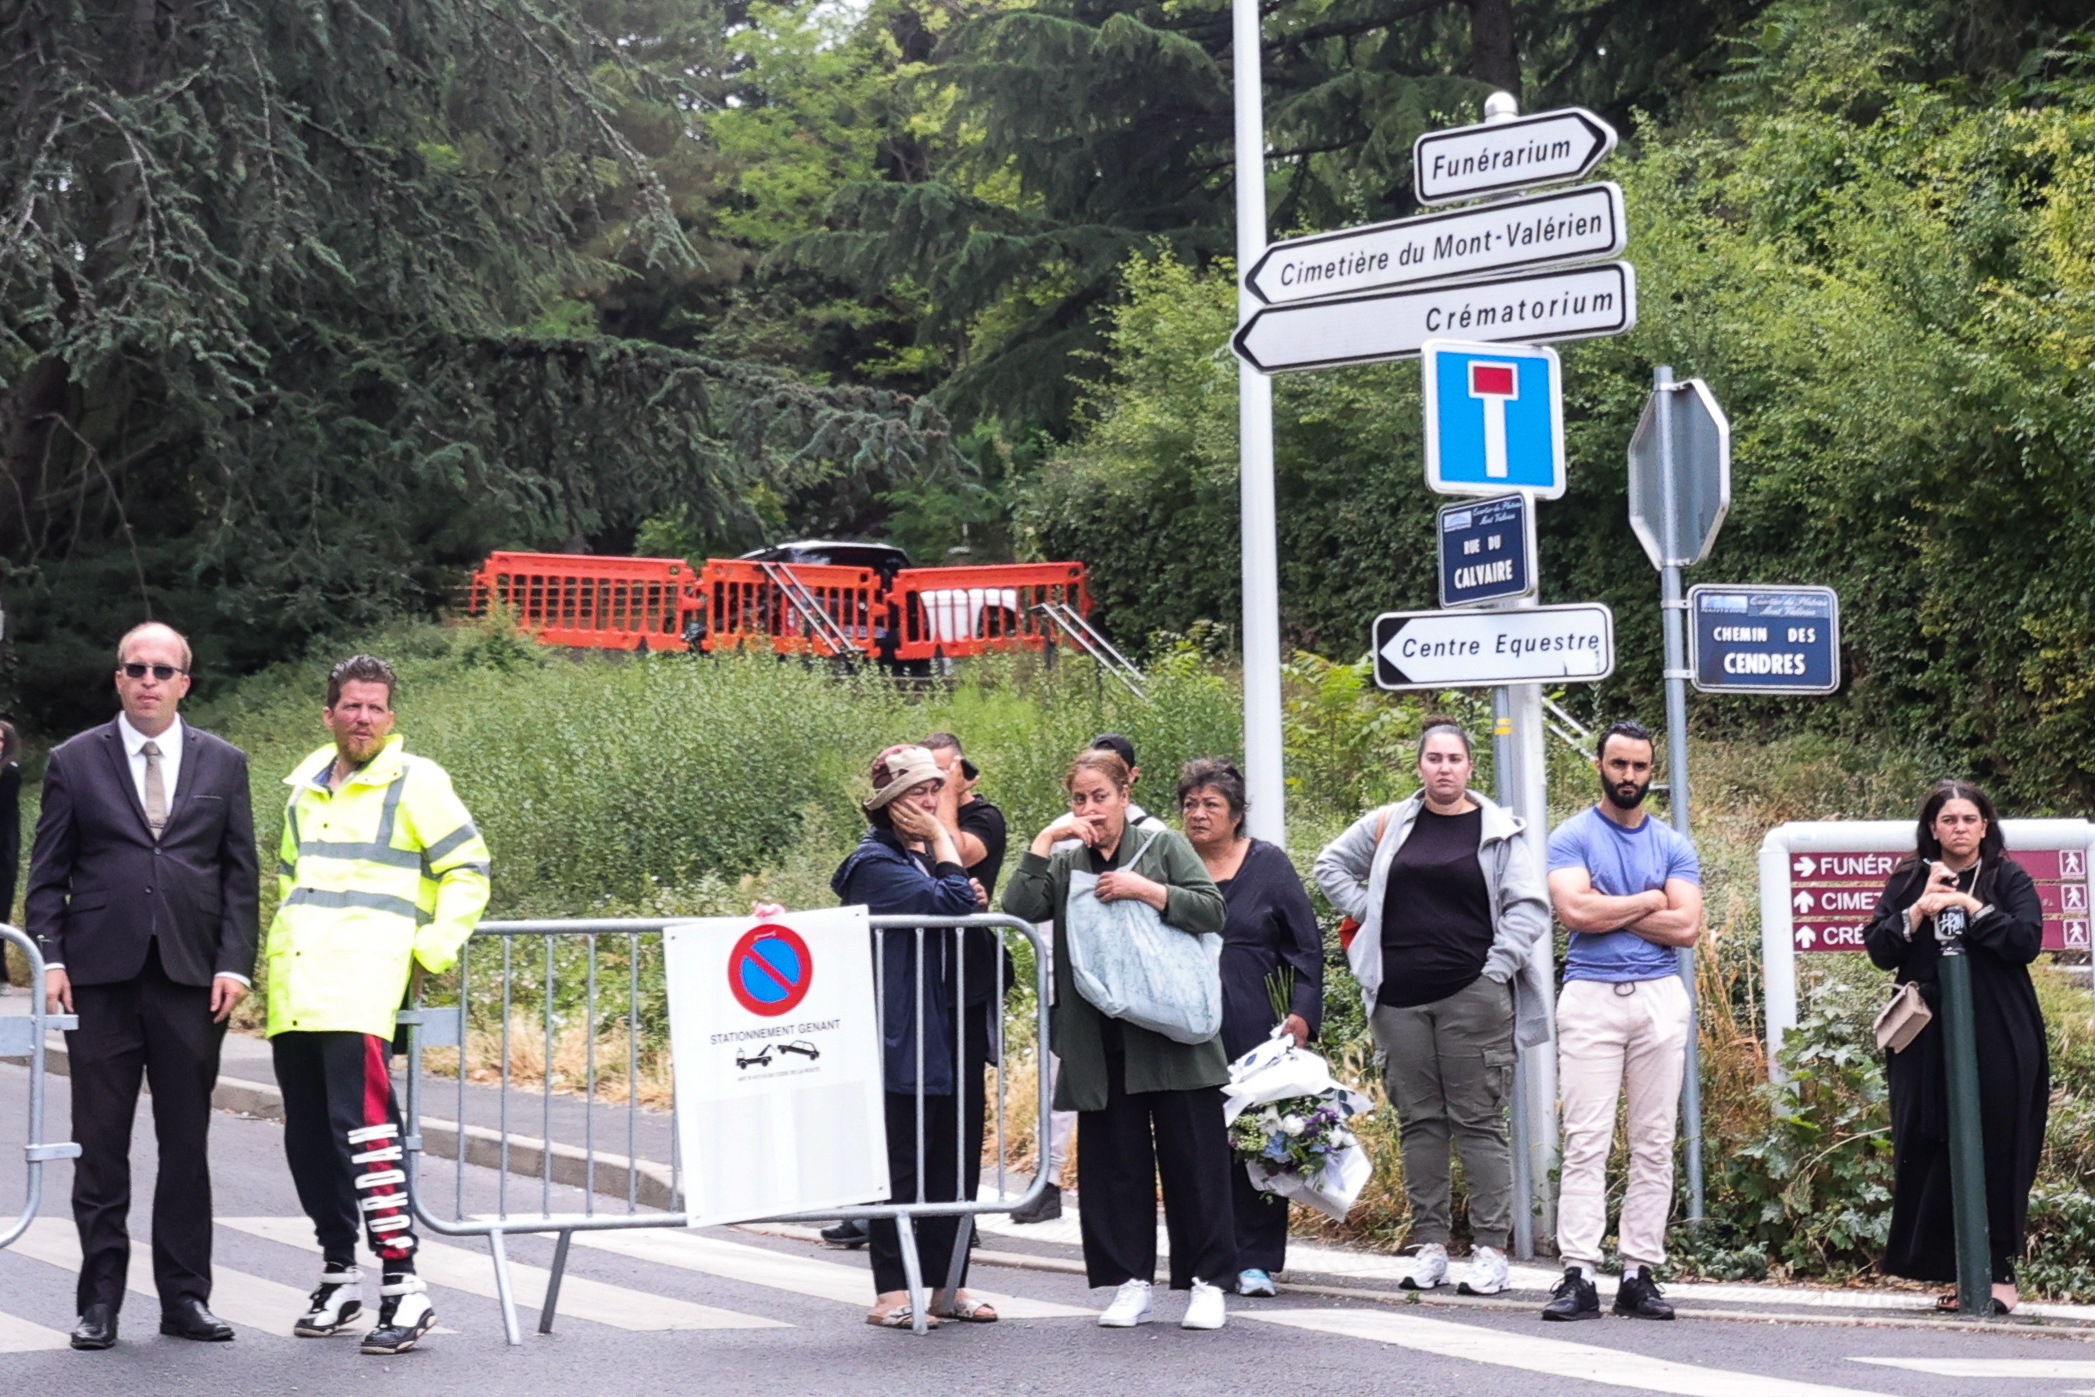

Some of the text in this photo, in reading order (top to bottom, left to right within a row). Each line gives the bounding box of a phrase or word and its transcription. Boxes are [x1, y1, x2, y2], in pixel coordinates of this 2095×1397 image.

[1432, 140, 1571, 180] Funérarium
[1280, 213, 1603, 287] Cimetière du Mont-Valérien
[1425, 292, 1614, 332] Crématorium
[1463, 534, 1502, 556] RUE DU
[1454, 559, 1513, 590] CALVAIRE
[1402, 632, 1600, 658] Centre Equestre
[1713, 626, 1816, 643] CHEMIN DES
[1723, 652, 1807, 676] CENDRES
[710, 1019, 841, 1045] STATIONNEMENT GENANT
[348, 1123, 414, 1250] JORDAN
